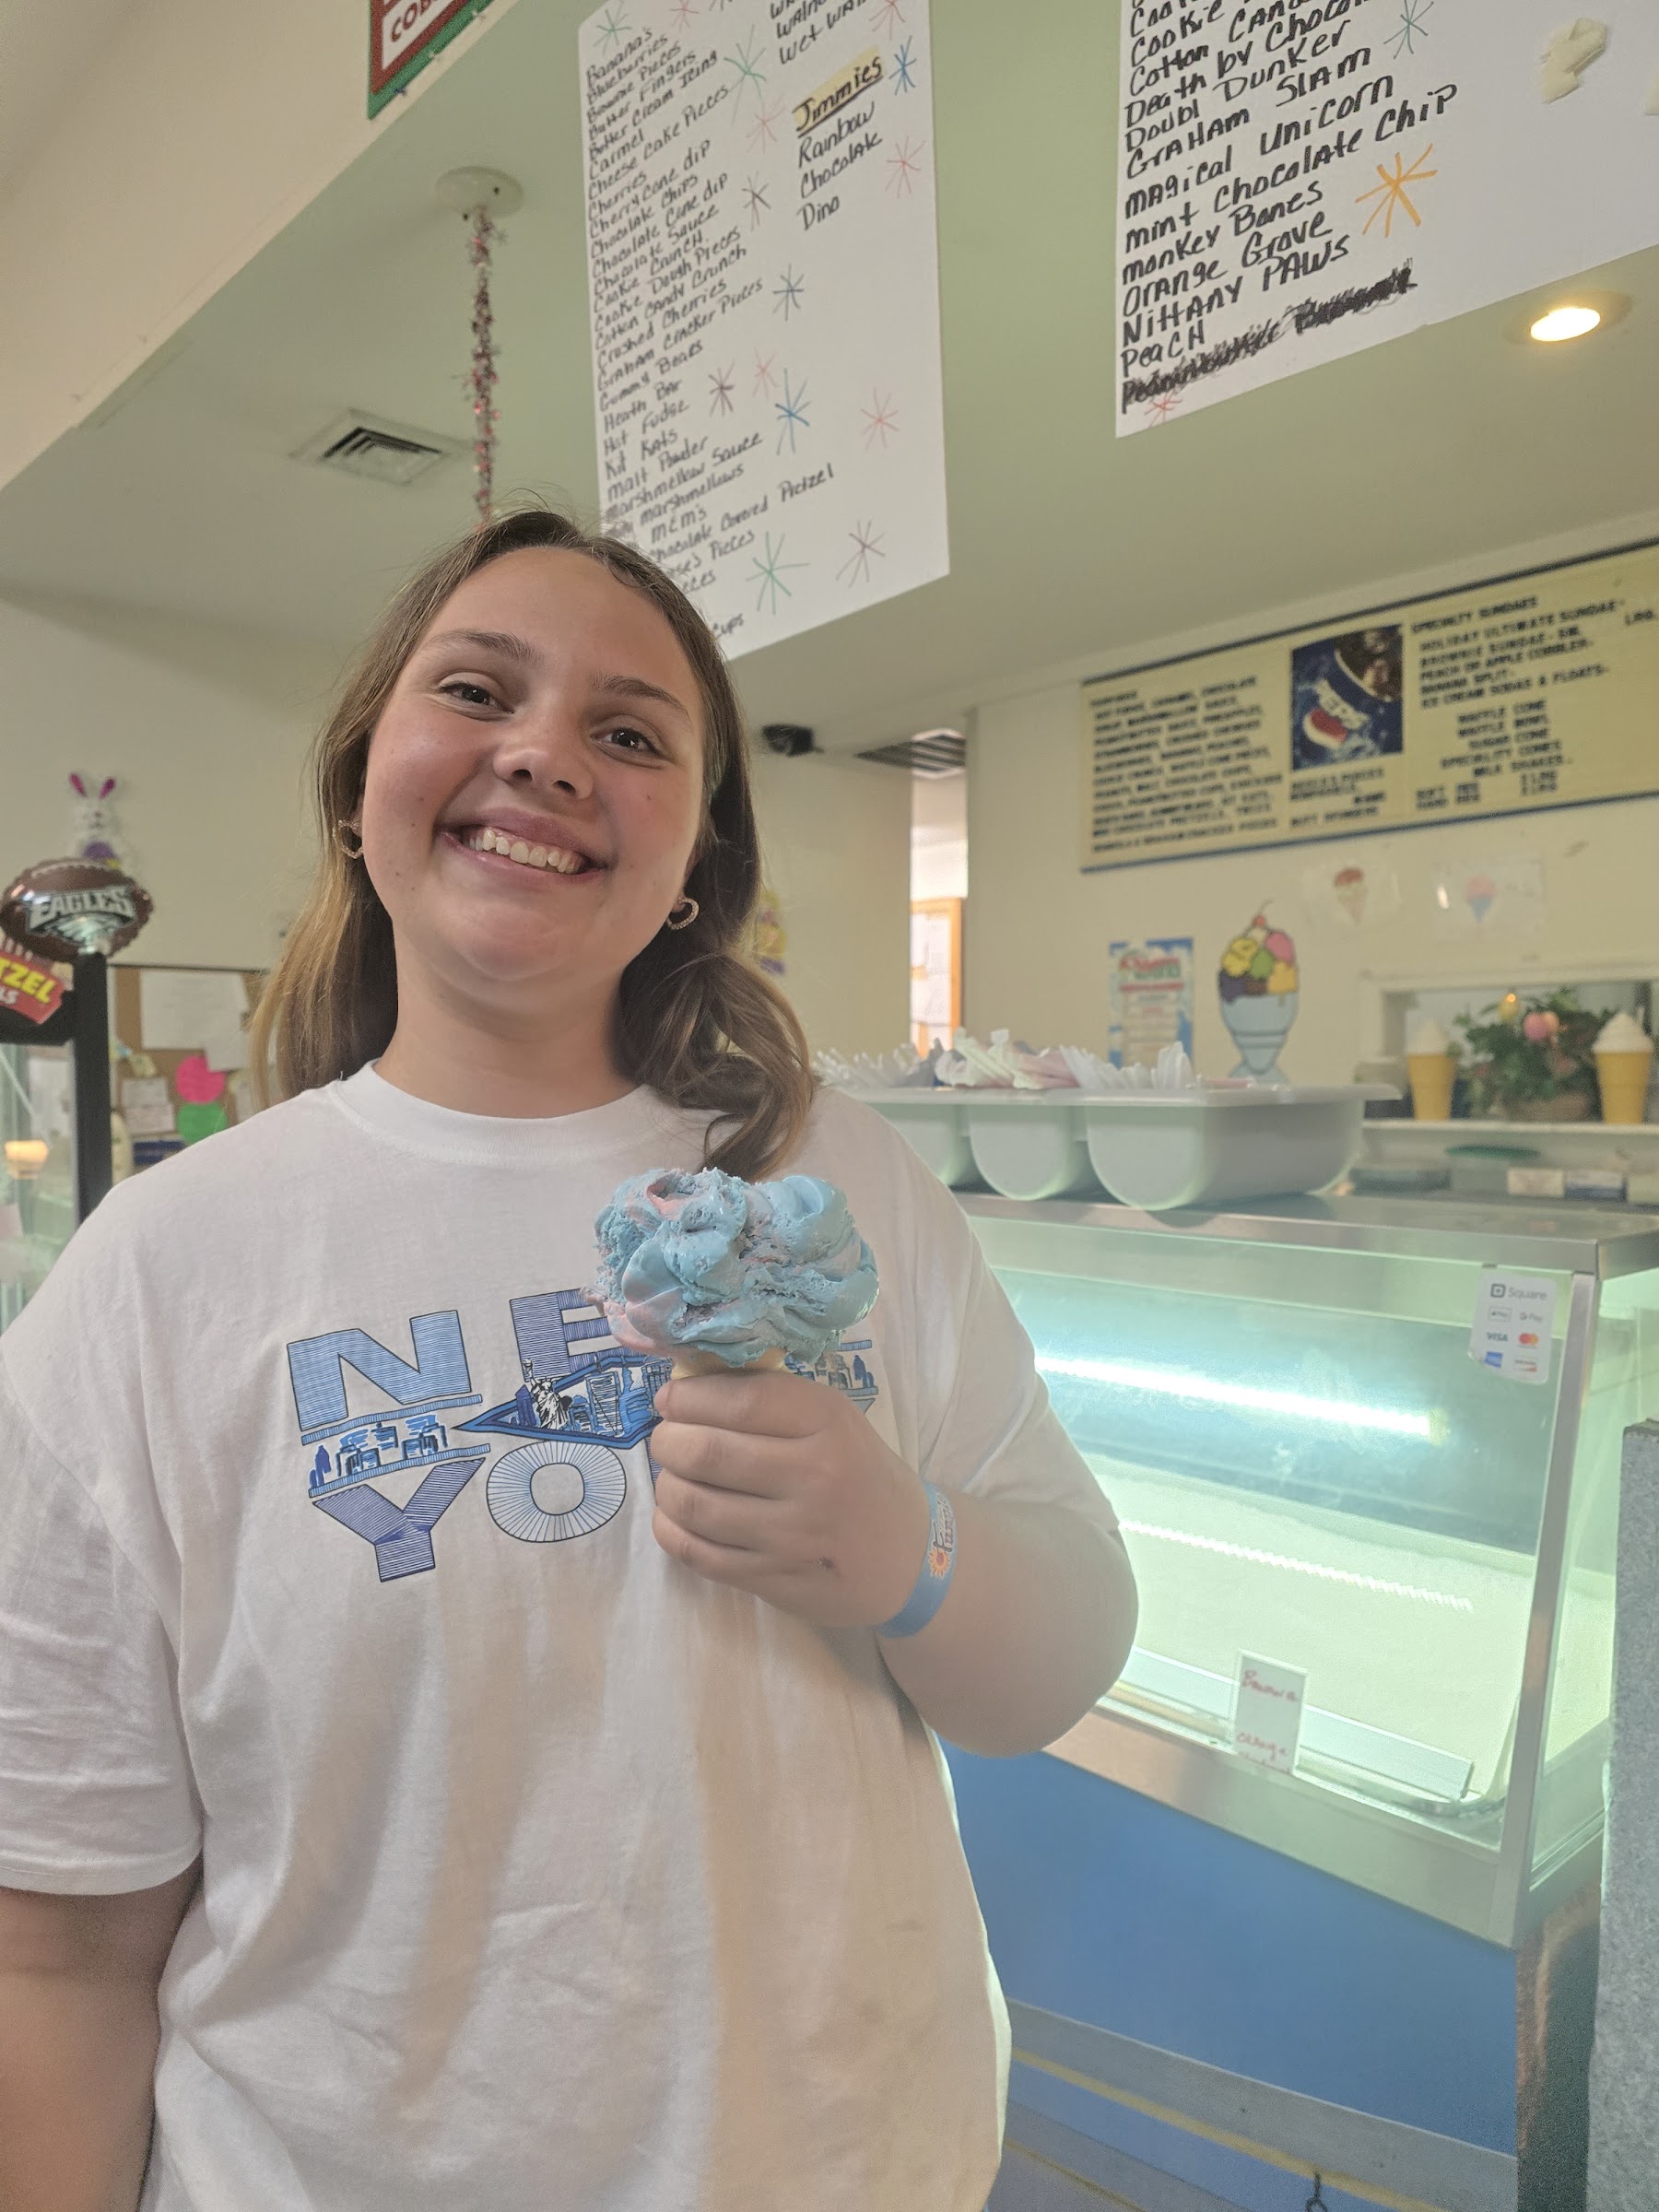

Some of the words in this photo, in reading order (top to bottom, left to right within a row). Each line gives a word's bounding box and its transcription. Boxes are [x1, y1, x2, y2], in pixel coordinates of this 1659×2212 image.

[792, 56, 883, 132] Jimmies
[1124, 74, 1207, 128] Death
[1217, 41, 1253, 81] by
[798, 100, 875, 170] Rainbow
[796, 195, 841, 231] Dino
[1124, 201, 1199, 254] mint
[712, 432, 764, 467] Sauce
[777, 462, 835, 503] Pretzel
[29, 886, 136, 925] EAGLES
[1509, 1286, 1548, 1301] Square
[1486, 1331, 1509, 1343] VISA
